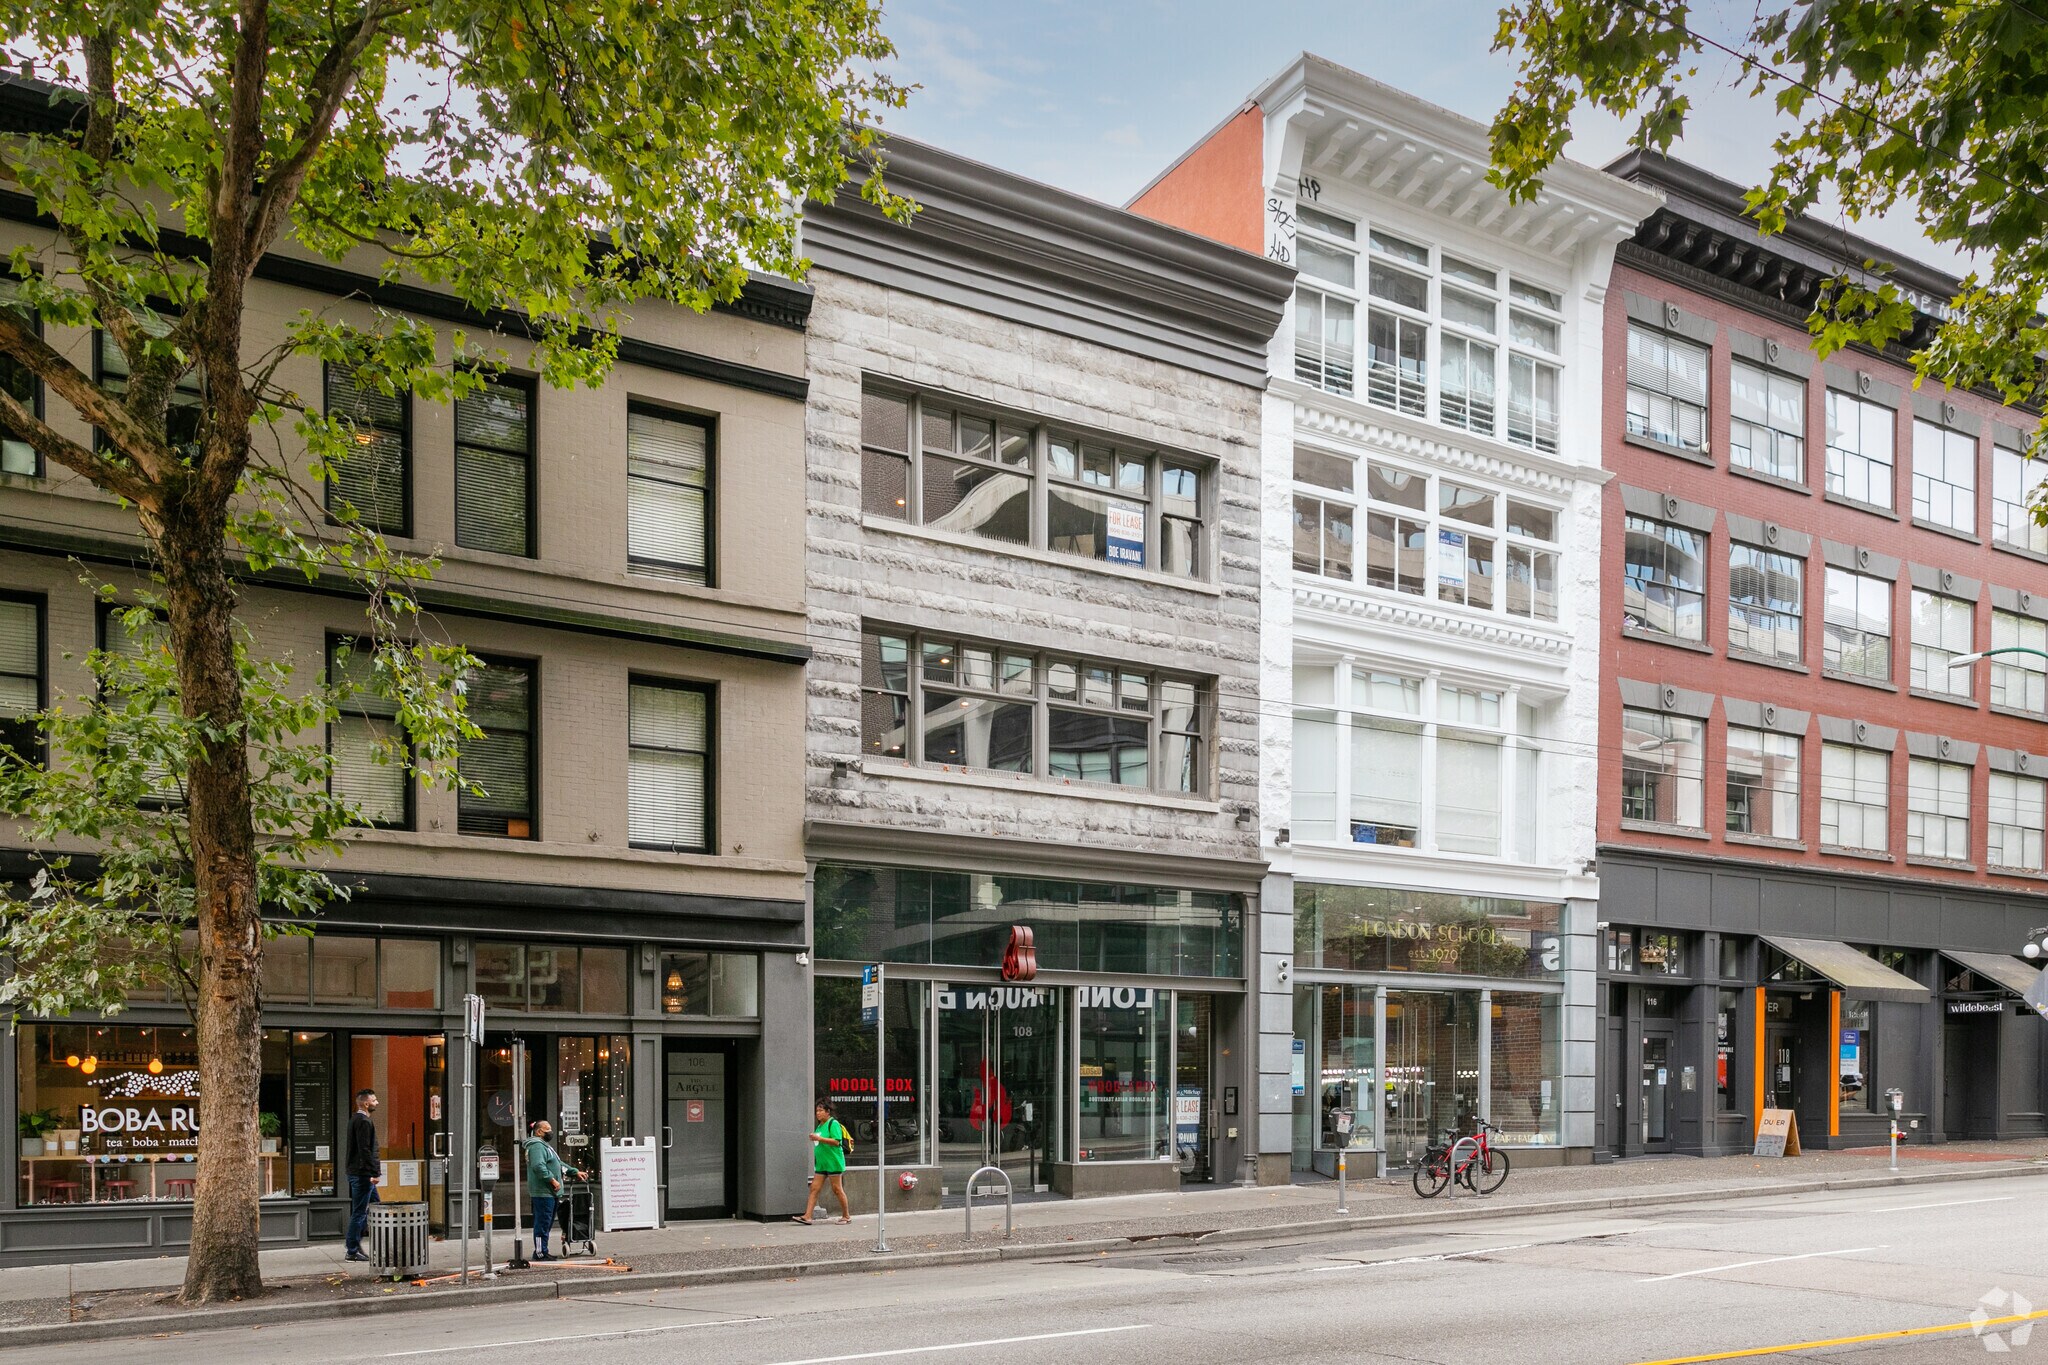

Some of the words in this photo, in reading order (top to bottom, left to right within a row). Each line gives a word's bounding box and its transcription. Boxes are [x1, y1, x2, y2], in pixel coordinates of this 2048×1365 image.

[1109, 511, 1121, 525] FOR
[1122, 514, 1142, 531] LEASE
[1363, 920, 1431, 940] LONDON
[1438, 925, 1500, 945] SCHOOL
[1647, 998, 1658, 1006] 116
[1951, 1002, 2005, 1013] wildebeest
[1012, 1026, 1033, 1037] 108
[688, 1057, 706, 1067] 106
[1778, 1048, 1790, 1064] 118
[1181, 1100, 1199, 1113] LEASE
[81, 1107, 166, 1132] BOBA
[106, 1139, 123, 1147] tea
[132, 1137, 159, 1147] boba
